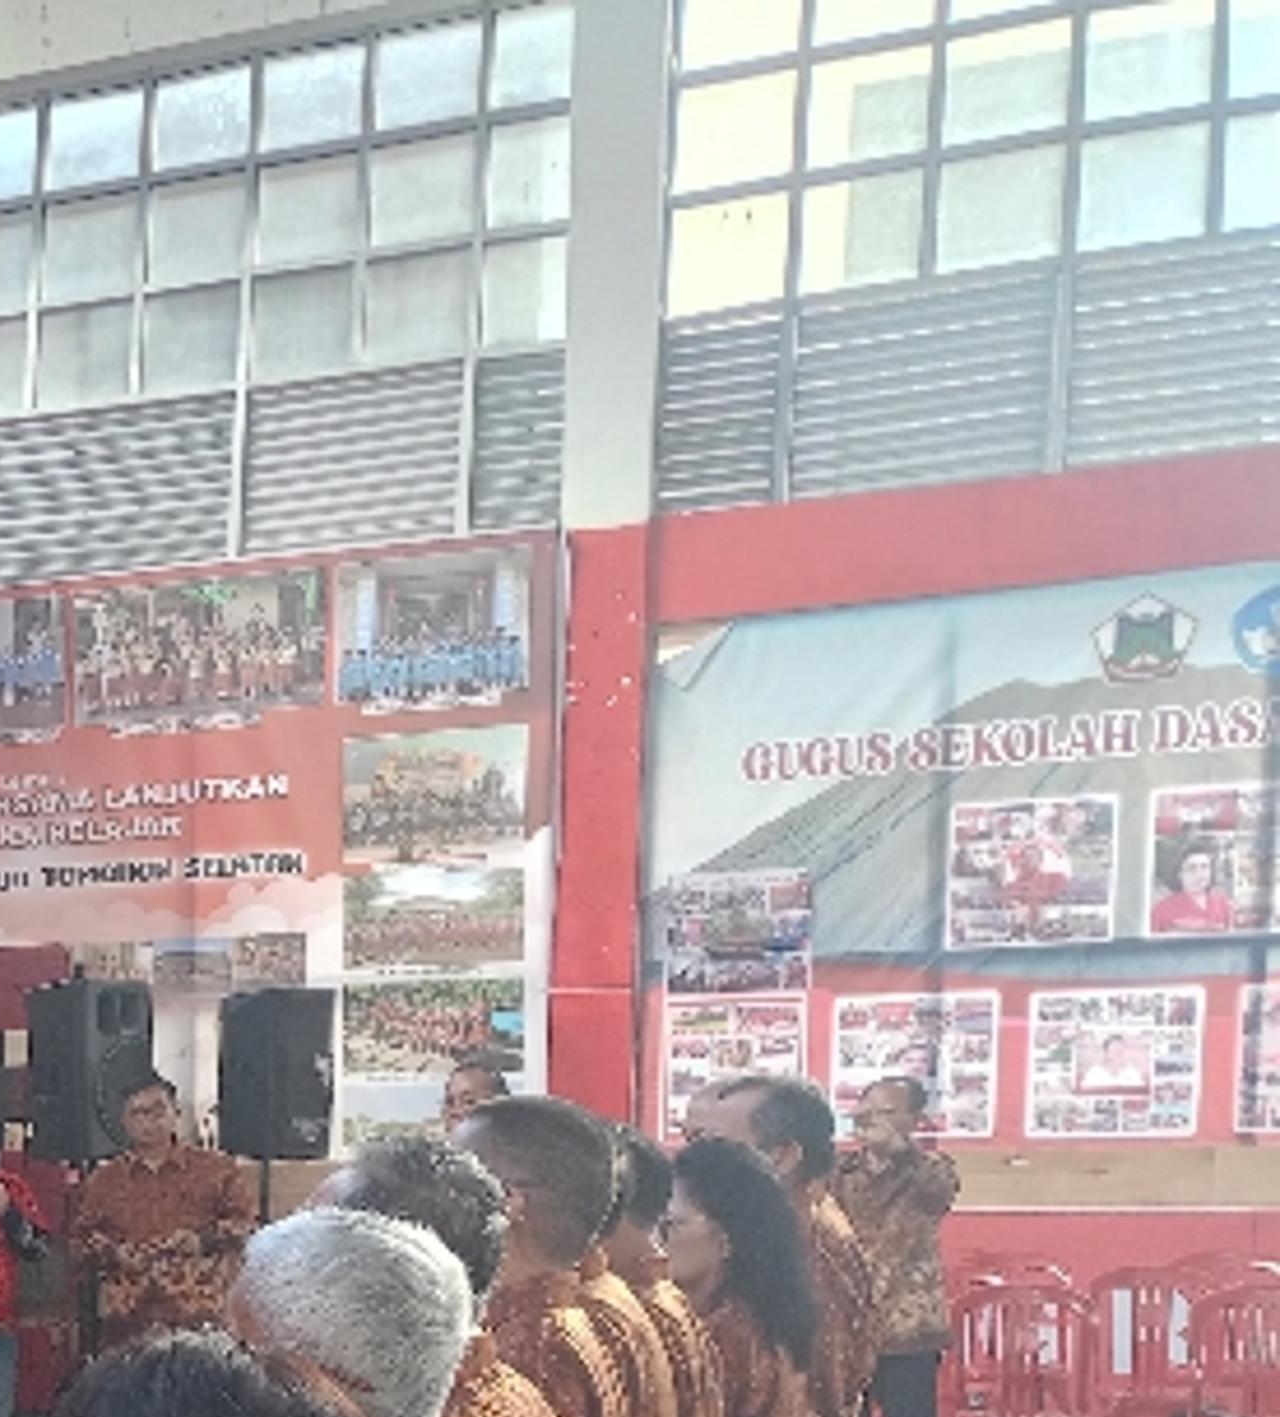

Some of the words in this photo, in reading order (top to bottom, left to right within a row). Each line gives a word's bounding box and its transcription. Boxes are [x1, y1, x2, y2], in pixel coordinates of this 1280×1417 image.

[741, 729, 894, 782] GUGUS
[907, 710, 1137, 772] SEKOLAH
[104, 773, 287, 809] LANJUTKAN
